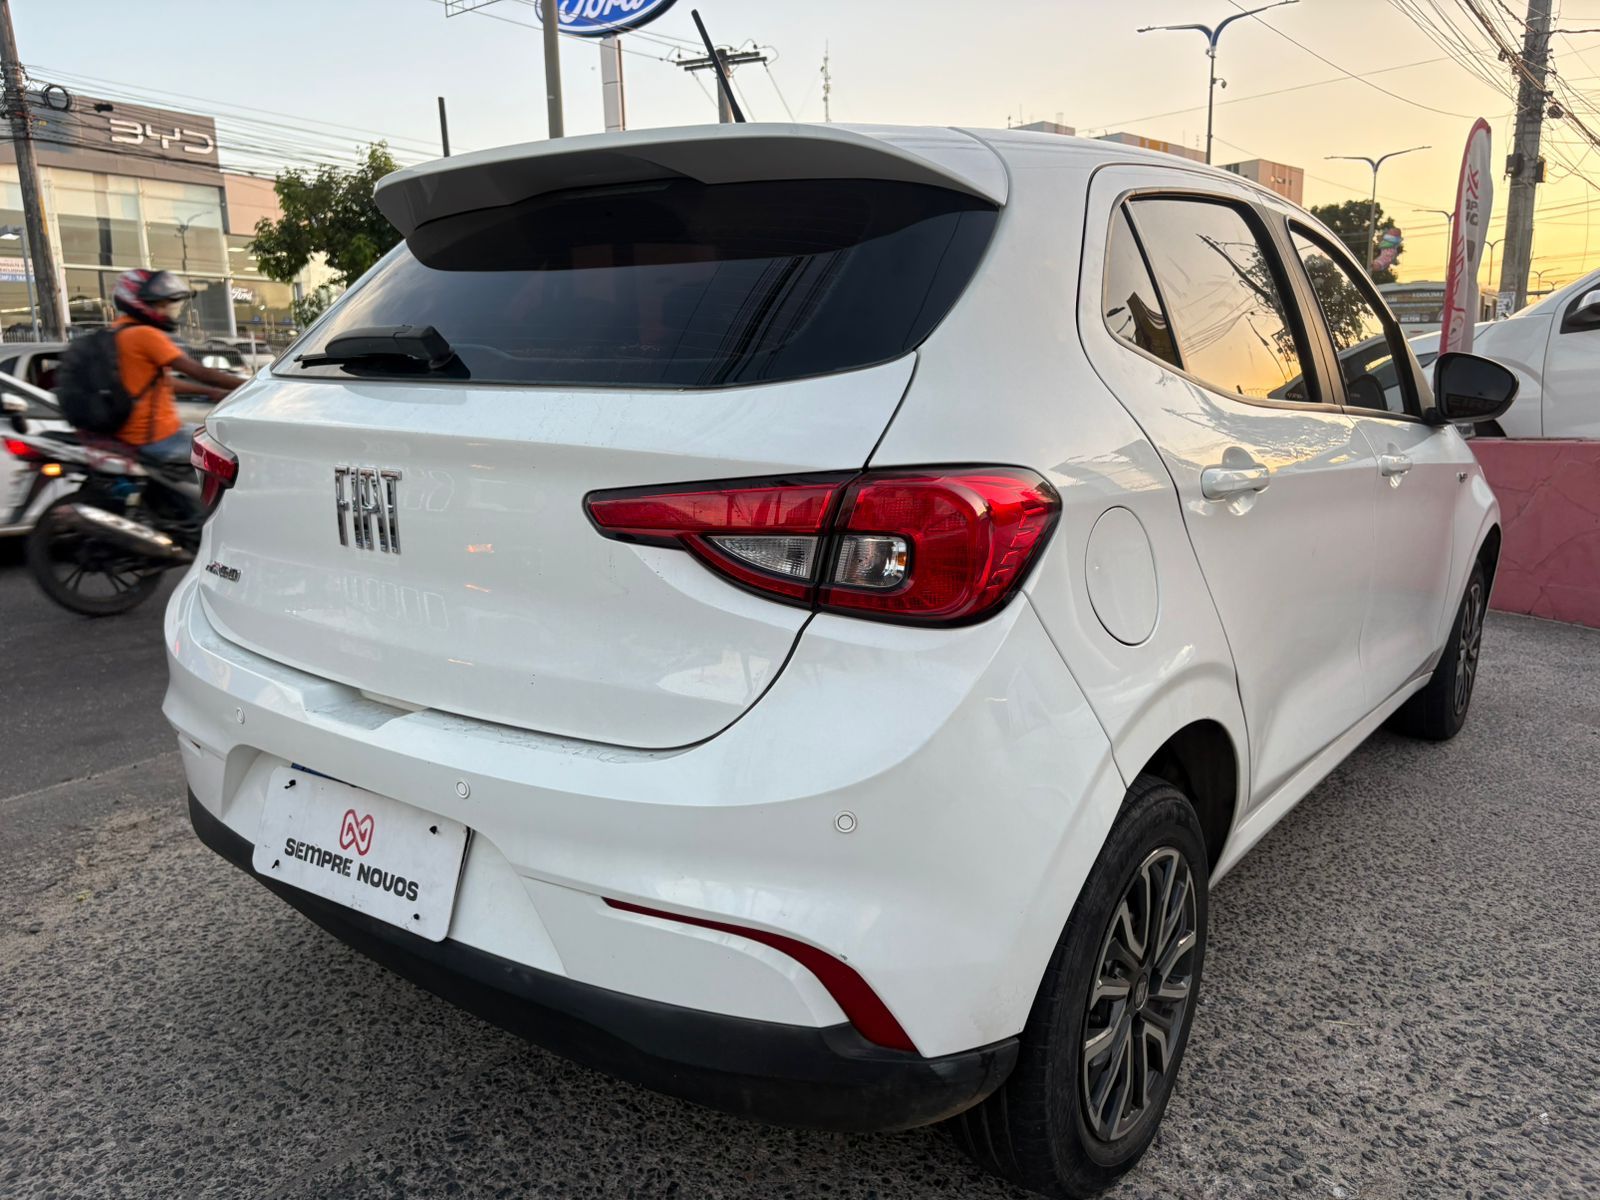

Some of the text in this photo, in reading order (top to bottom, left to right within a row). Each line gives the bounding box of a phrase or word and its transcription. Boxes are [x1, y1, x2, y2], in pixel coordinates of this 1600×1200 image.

[110, 118, 214, 155] BYD
[334, 465, 402, 554] FIAT
[284, 837, 419, 902] SEMPRE NOVOS
